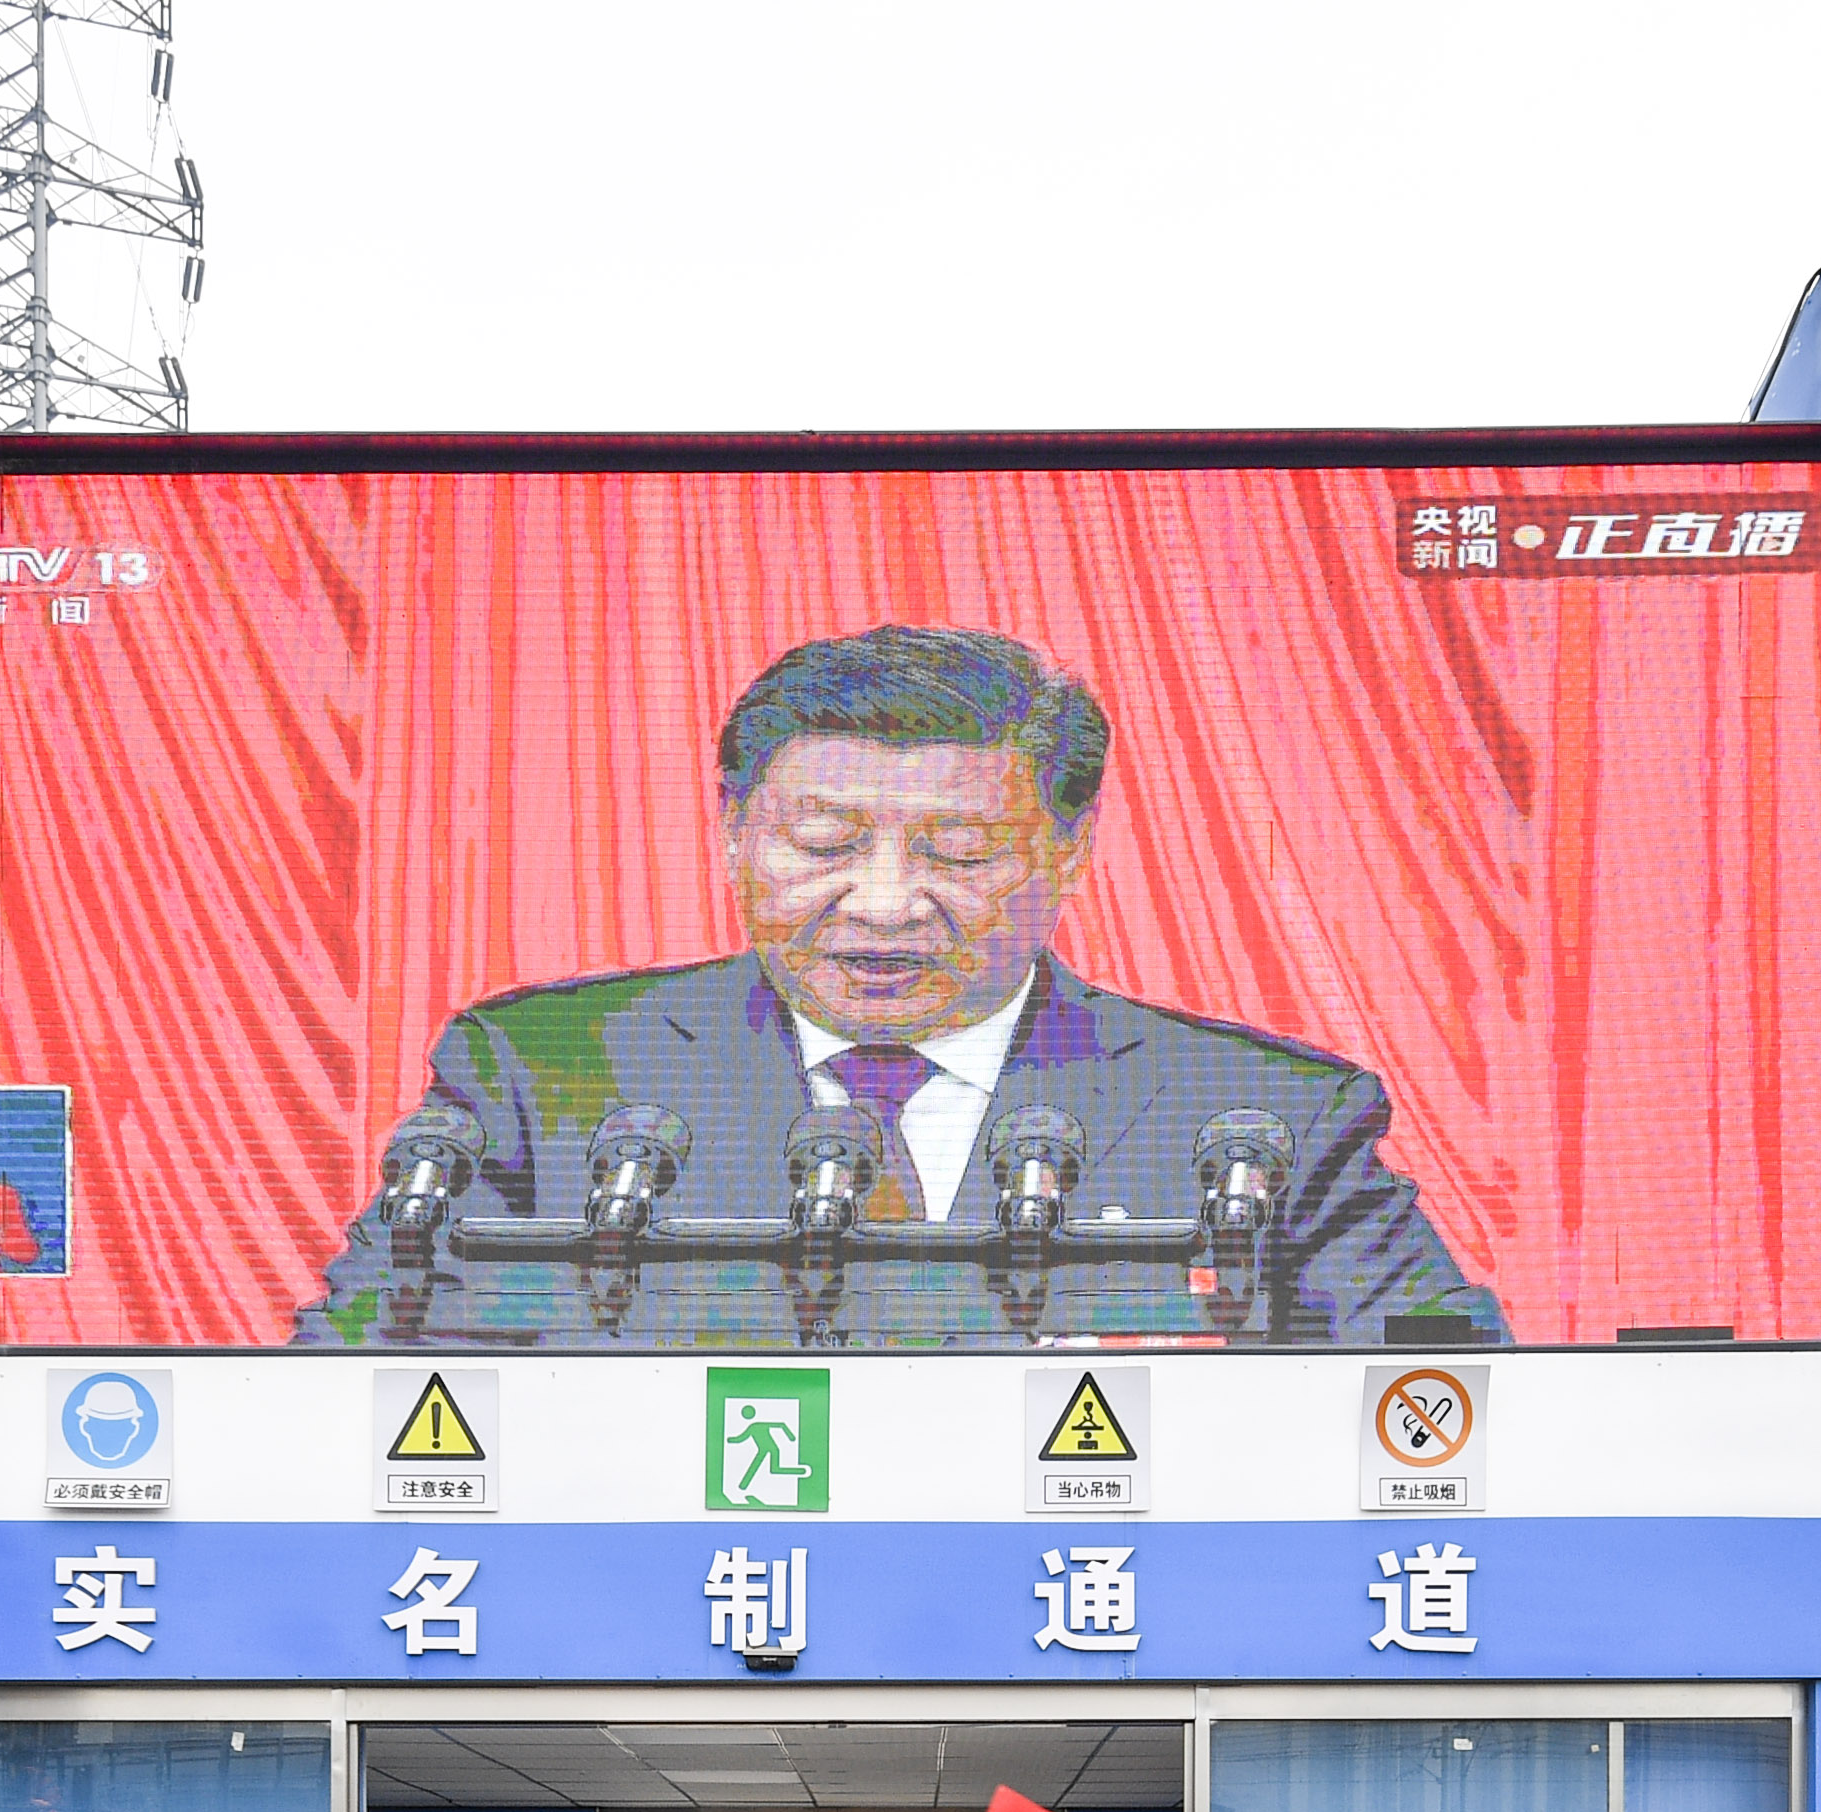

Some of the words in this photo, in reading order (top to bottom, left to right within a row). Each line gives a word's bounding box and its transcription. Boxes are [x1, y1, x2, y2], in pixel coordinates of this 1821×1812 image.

[1412, 505, 1498, 536] 央视
[1412, 539, 1498, 569] 新闻
[94, 552, 150, 585] 13
[53, 1483, 163, 1502] 必须戴安全帽
[401, 1480, 475, 1500] 注意安全
[1056, 1480, 1122, 1501] 当心吊物
[1390, 1481, 1457, 1502] 禁止吸烟
[52, 1542, 1479, 1655] 实名制通道
